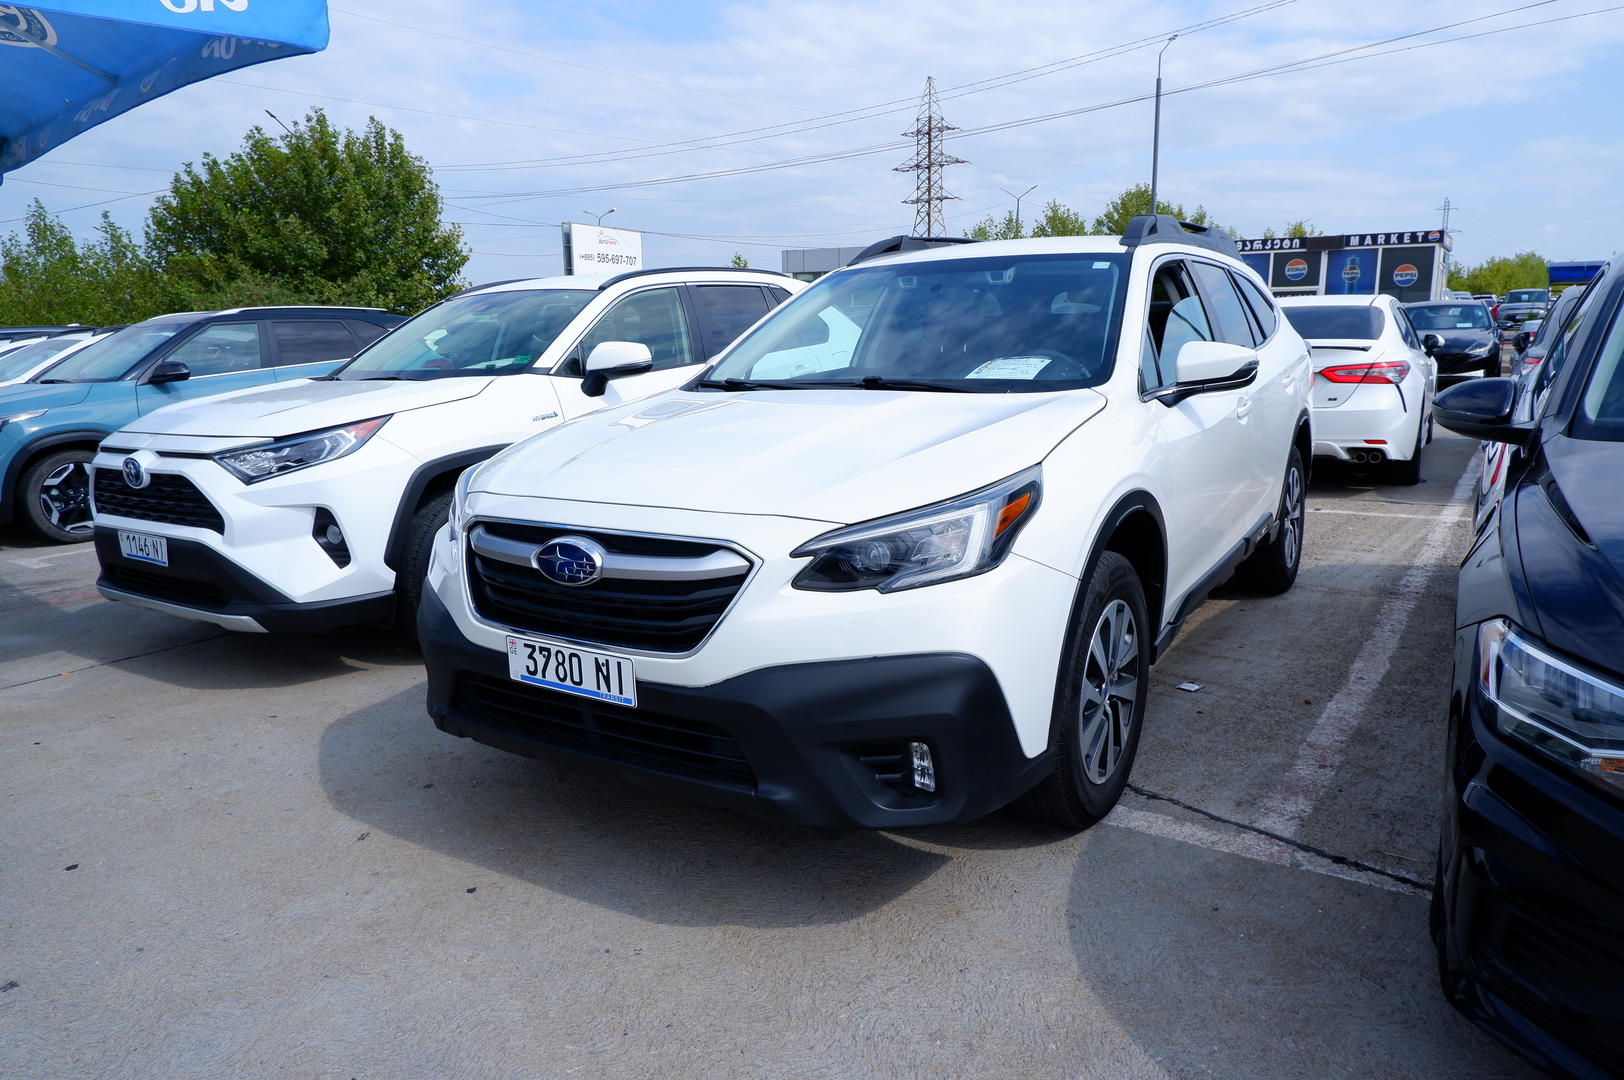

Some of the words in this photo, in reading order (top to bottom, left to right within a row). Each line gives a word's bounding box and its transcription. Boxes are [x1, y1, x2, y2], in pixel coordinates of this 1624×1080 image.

[1350, 232, 1425, 246] MARKET
[597, 253, 637, 266] 595-697-707
[126, 534, 150, 557] 1146
[152, 538, 164, 561] NI
[523, 643, 584, 687] 3780
[594, 657, 624, 695] NI
